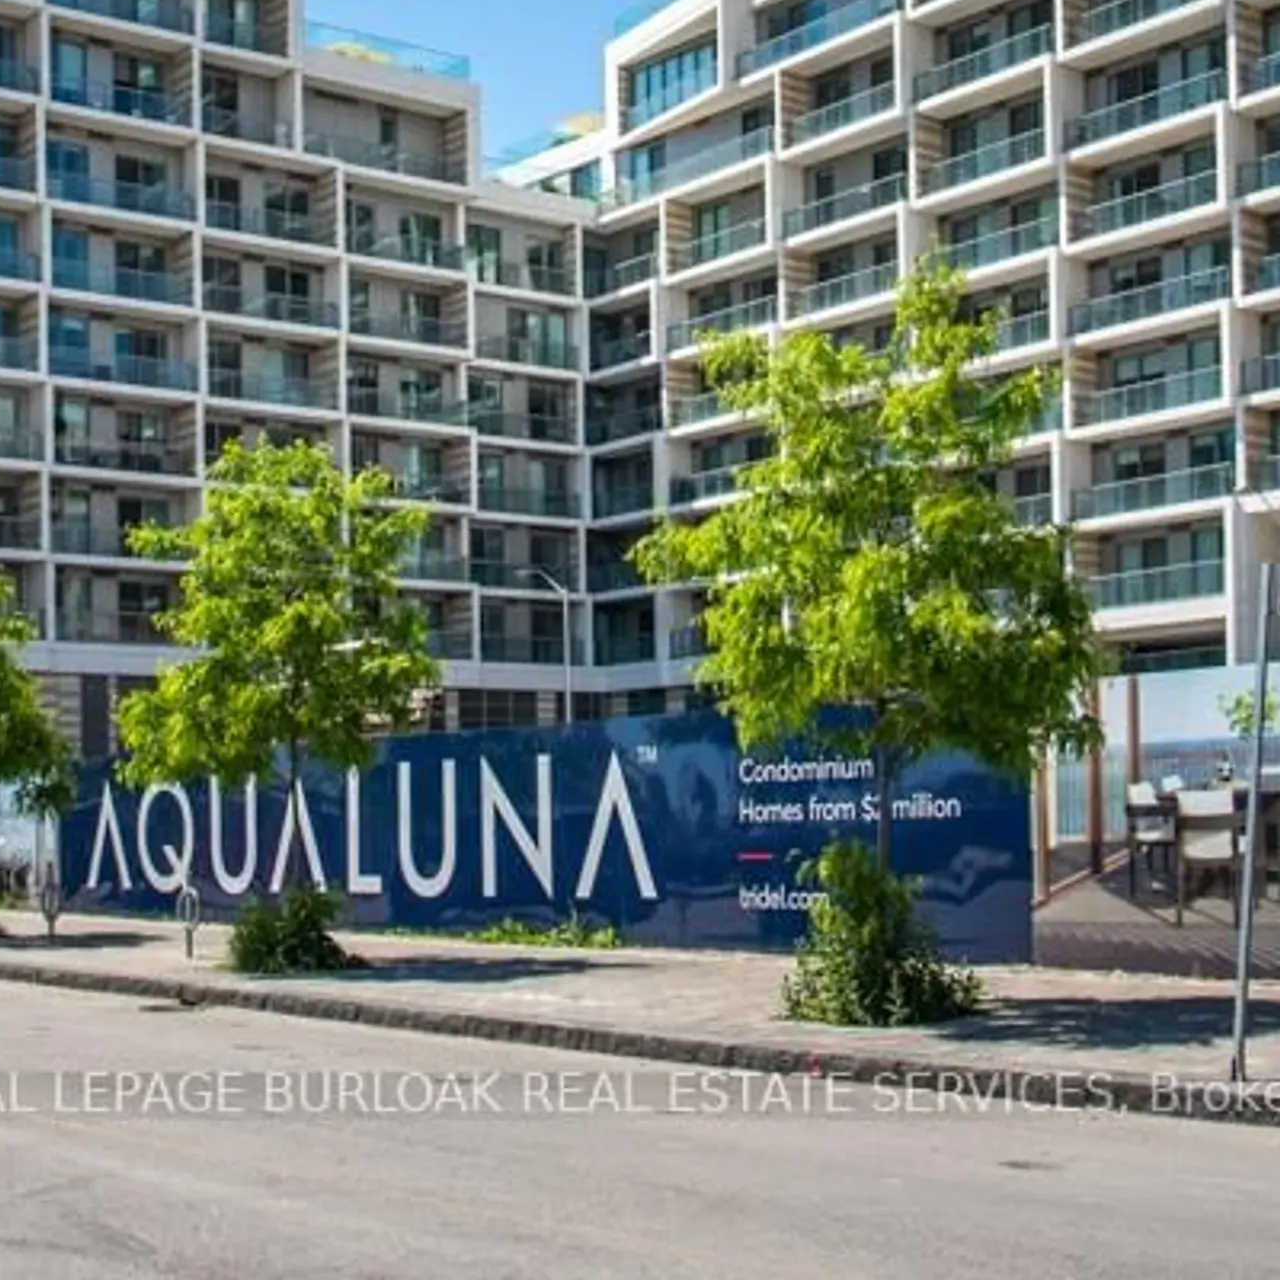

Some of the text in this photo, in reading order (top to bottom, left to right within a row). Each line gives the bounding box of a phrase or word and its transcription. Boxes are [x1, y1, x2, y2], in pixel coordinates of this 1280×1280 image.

[739, 755, 874, 784] Condominium
[739, 797, 804, 823] Homes
[809, 795, 856, 821] from
[892, 791, 962, 821] million
[86, 749, 657, 900] AQUALUNA
[739, 883, 830, 911] tridel.com
